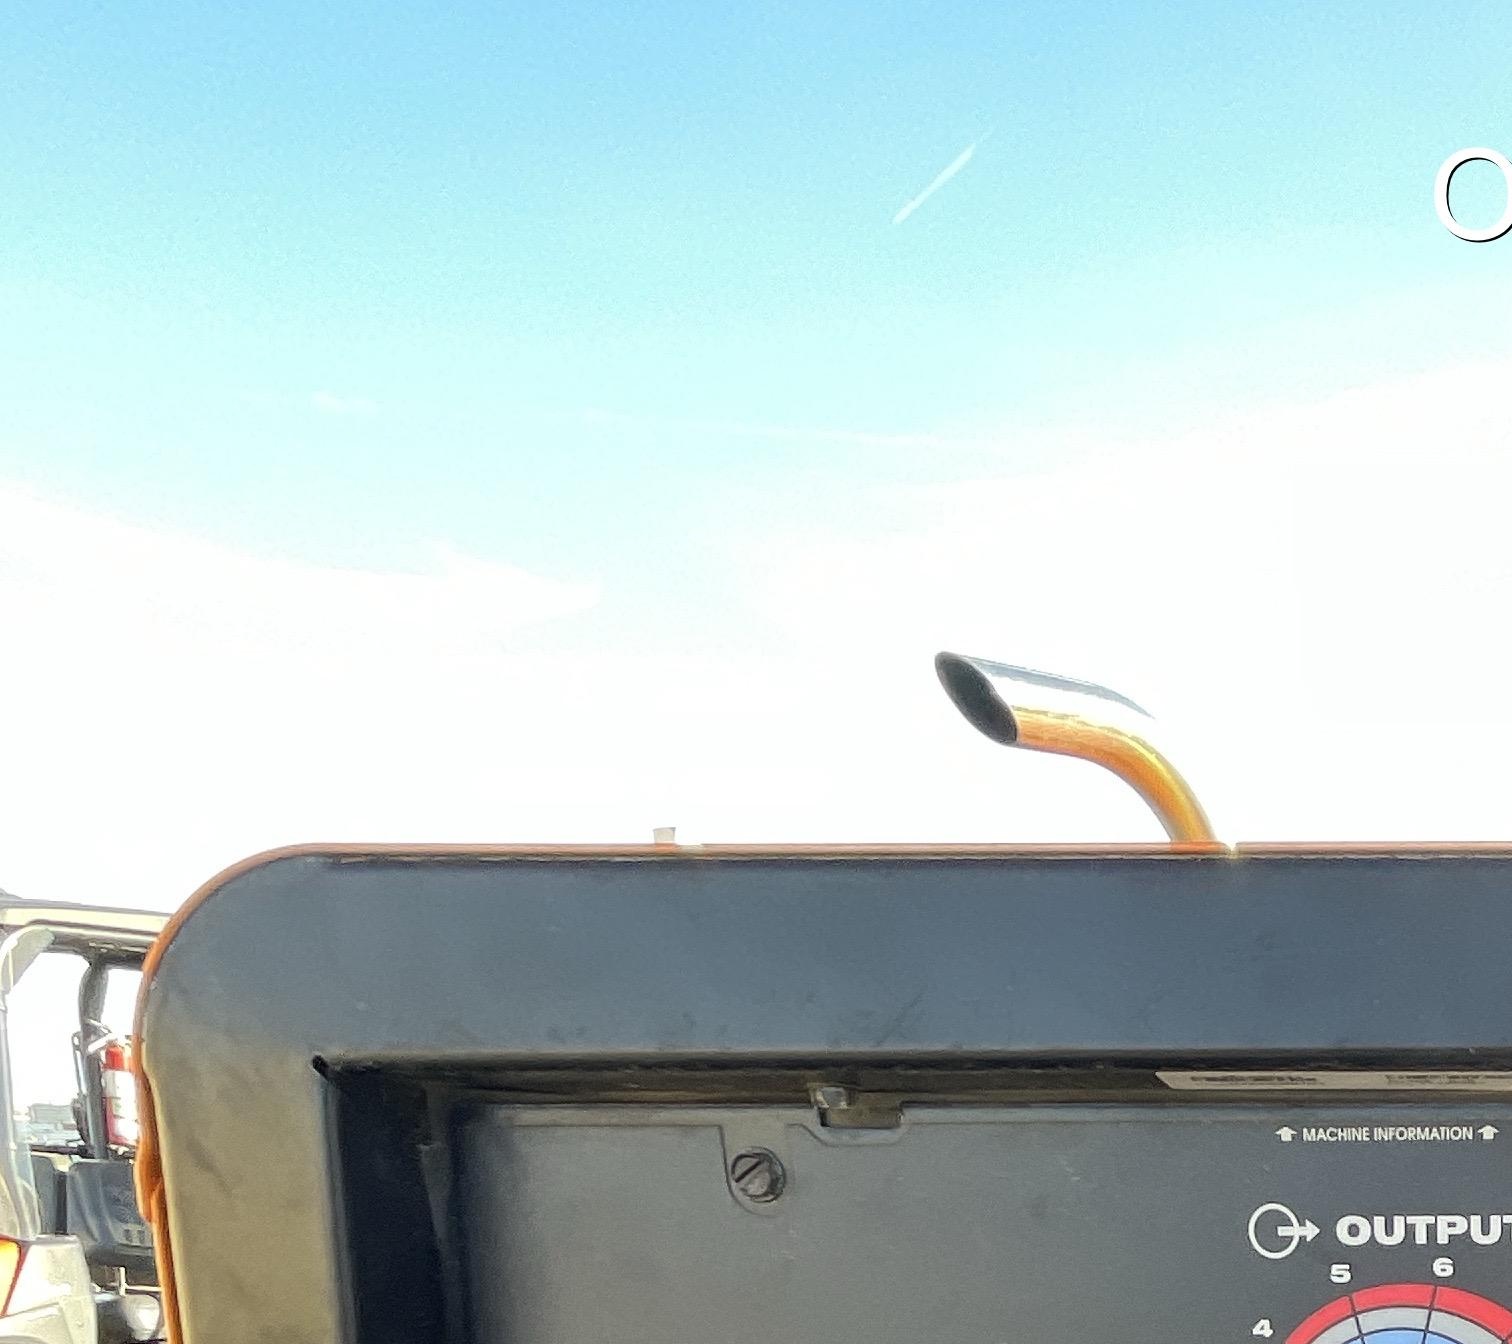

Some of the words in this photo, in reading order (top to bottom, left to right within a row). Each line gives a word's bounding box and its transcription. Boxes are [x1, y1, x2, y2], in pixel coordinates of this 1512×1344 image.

[1302, 1127, 1370, 1142] MACHINE
[1374, 1126, 1473, 1141] INFORMATION
[1330, 1264, 1352, 1284] 5
[1432, 1257, 1454, 1278] 6
[1252, 1319, 1274, 1338] 4
